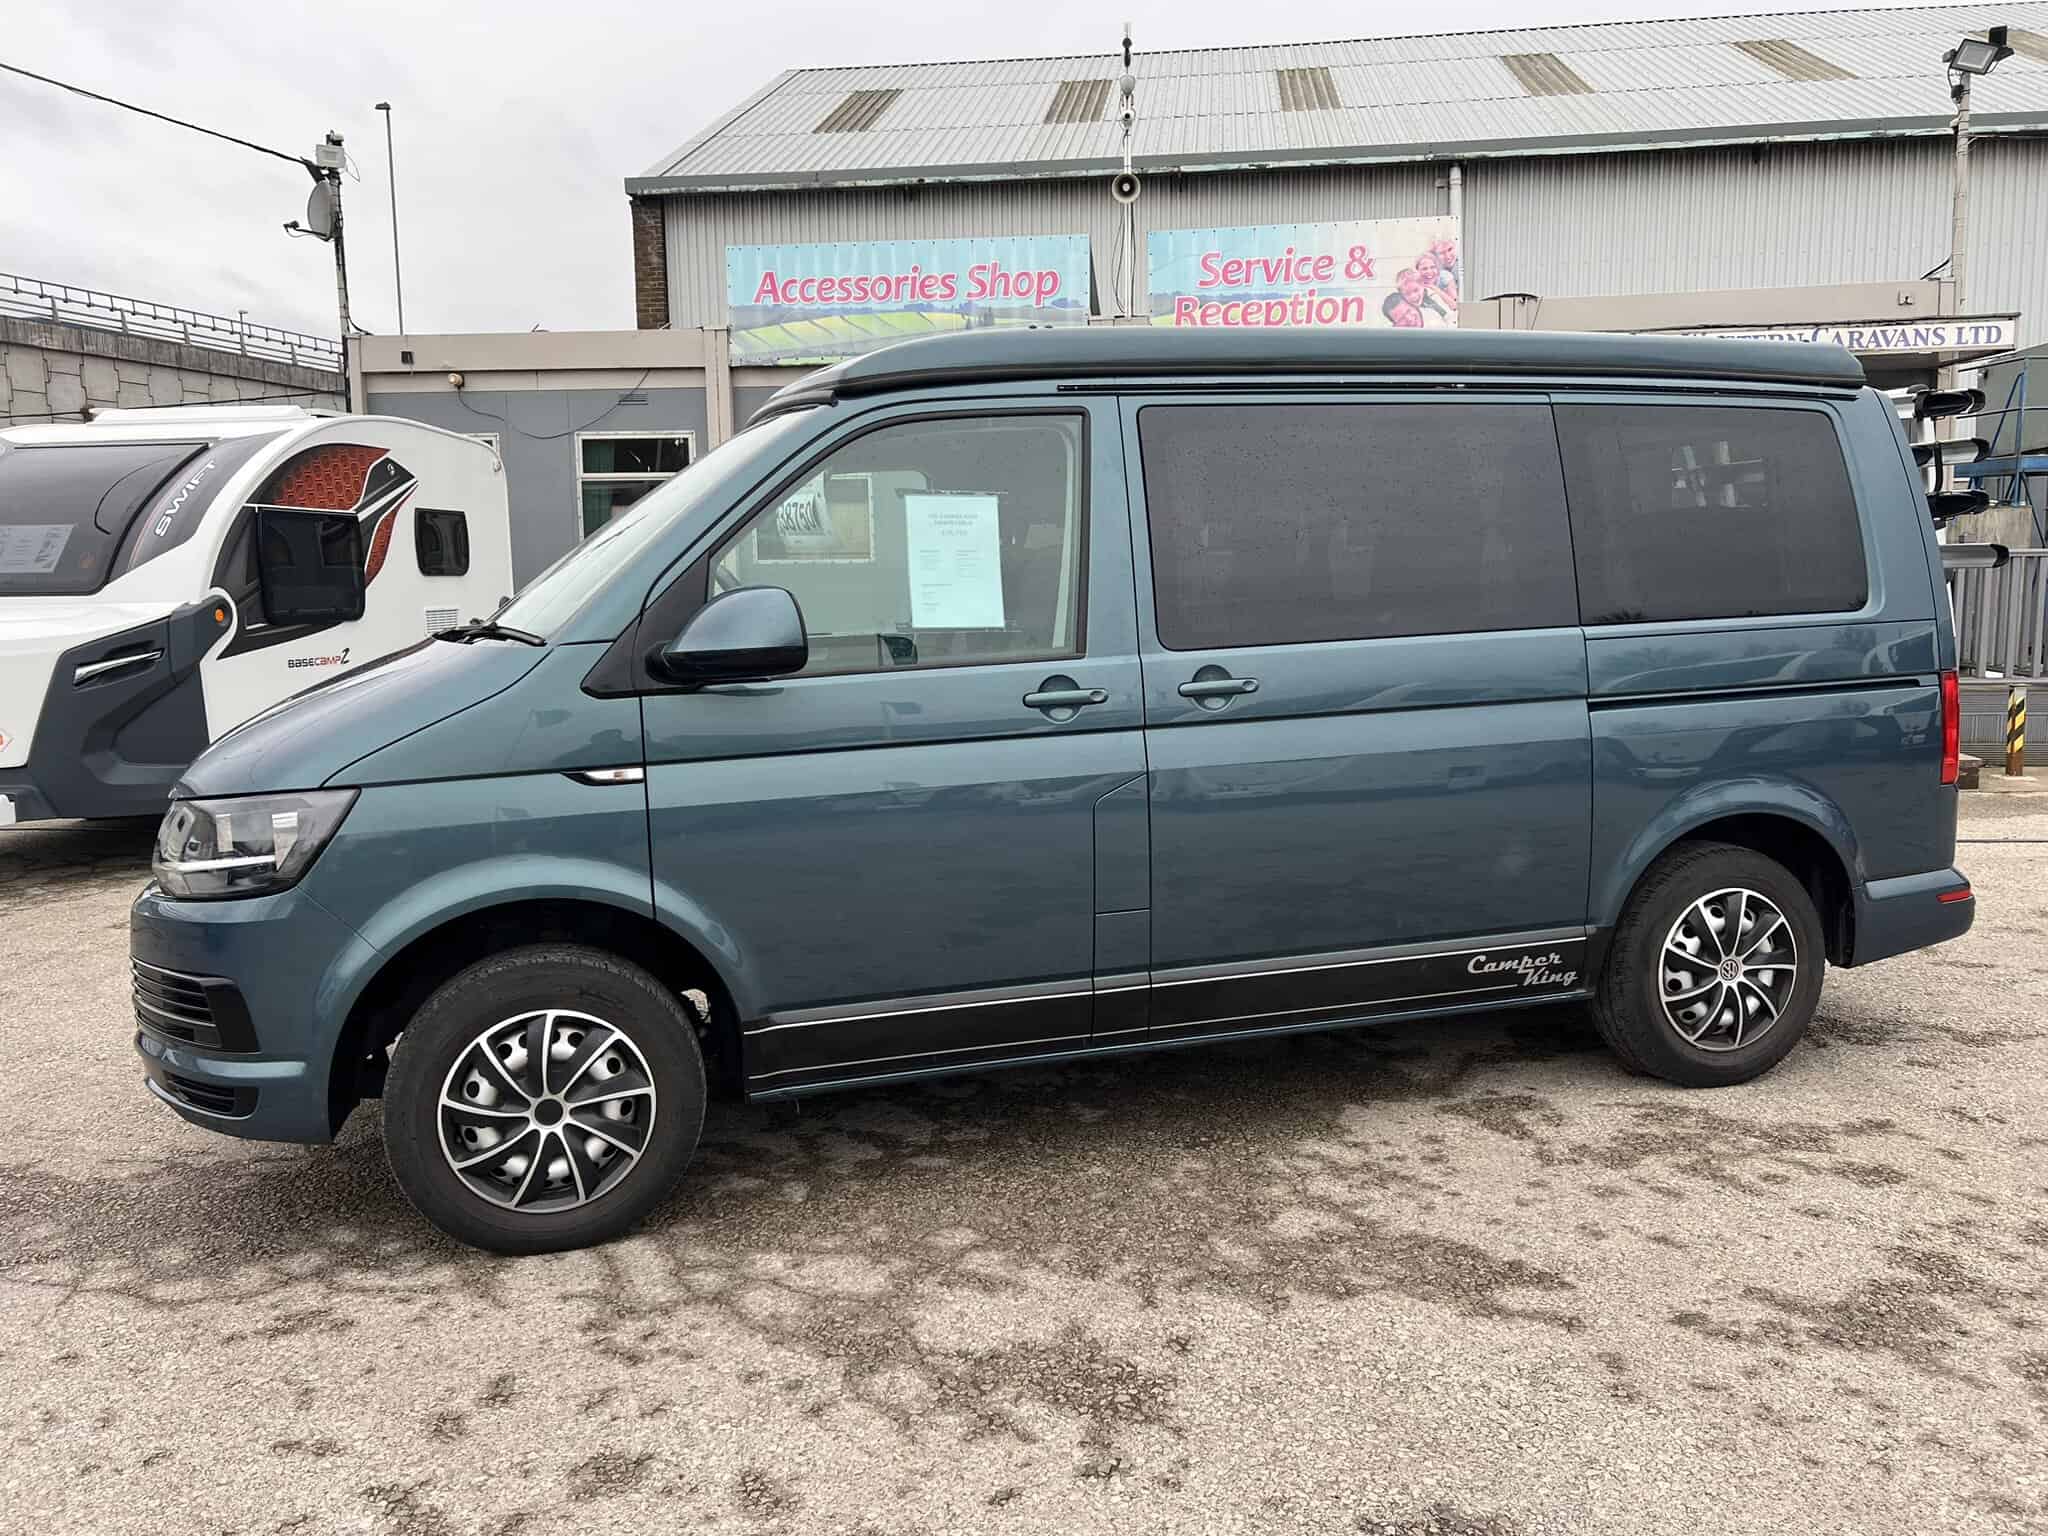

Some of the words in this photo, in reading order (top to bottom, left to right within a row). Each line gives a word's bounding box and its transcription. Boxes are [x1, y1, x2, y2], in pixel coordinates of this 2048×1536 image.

[752, 264, 957, 304] Accessories
[966, 260, 1061, 307] Shop
[1198, 246, 1336, 288] Service
[1343, 244, 1376, 279] &
[1174, 289, 1366, 327] Reception
[1956, 325, 2002, 345] LTD
[154, 460, 216, 537] SWIFT
[1467, 952, 1563, 974] Camper
[1522, 966, 1579, 986] King
